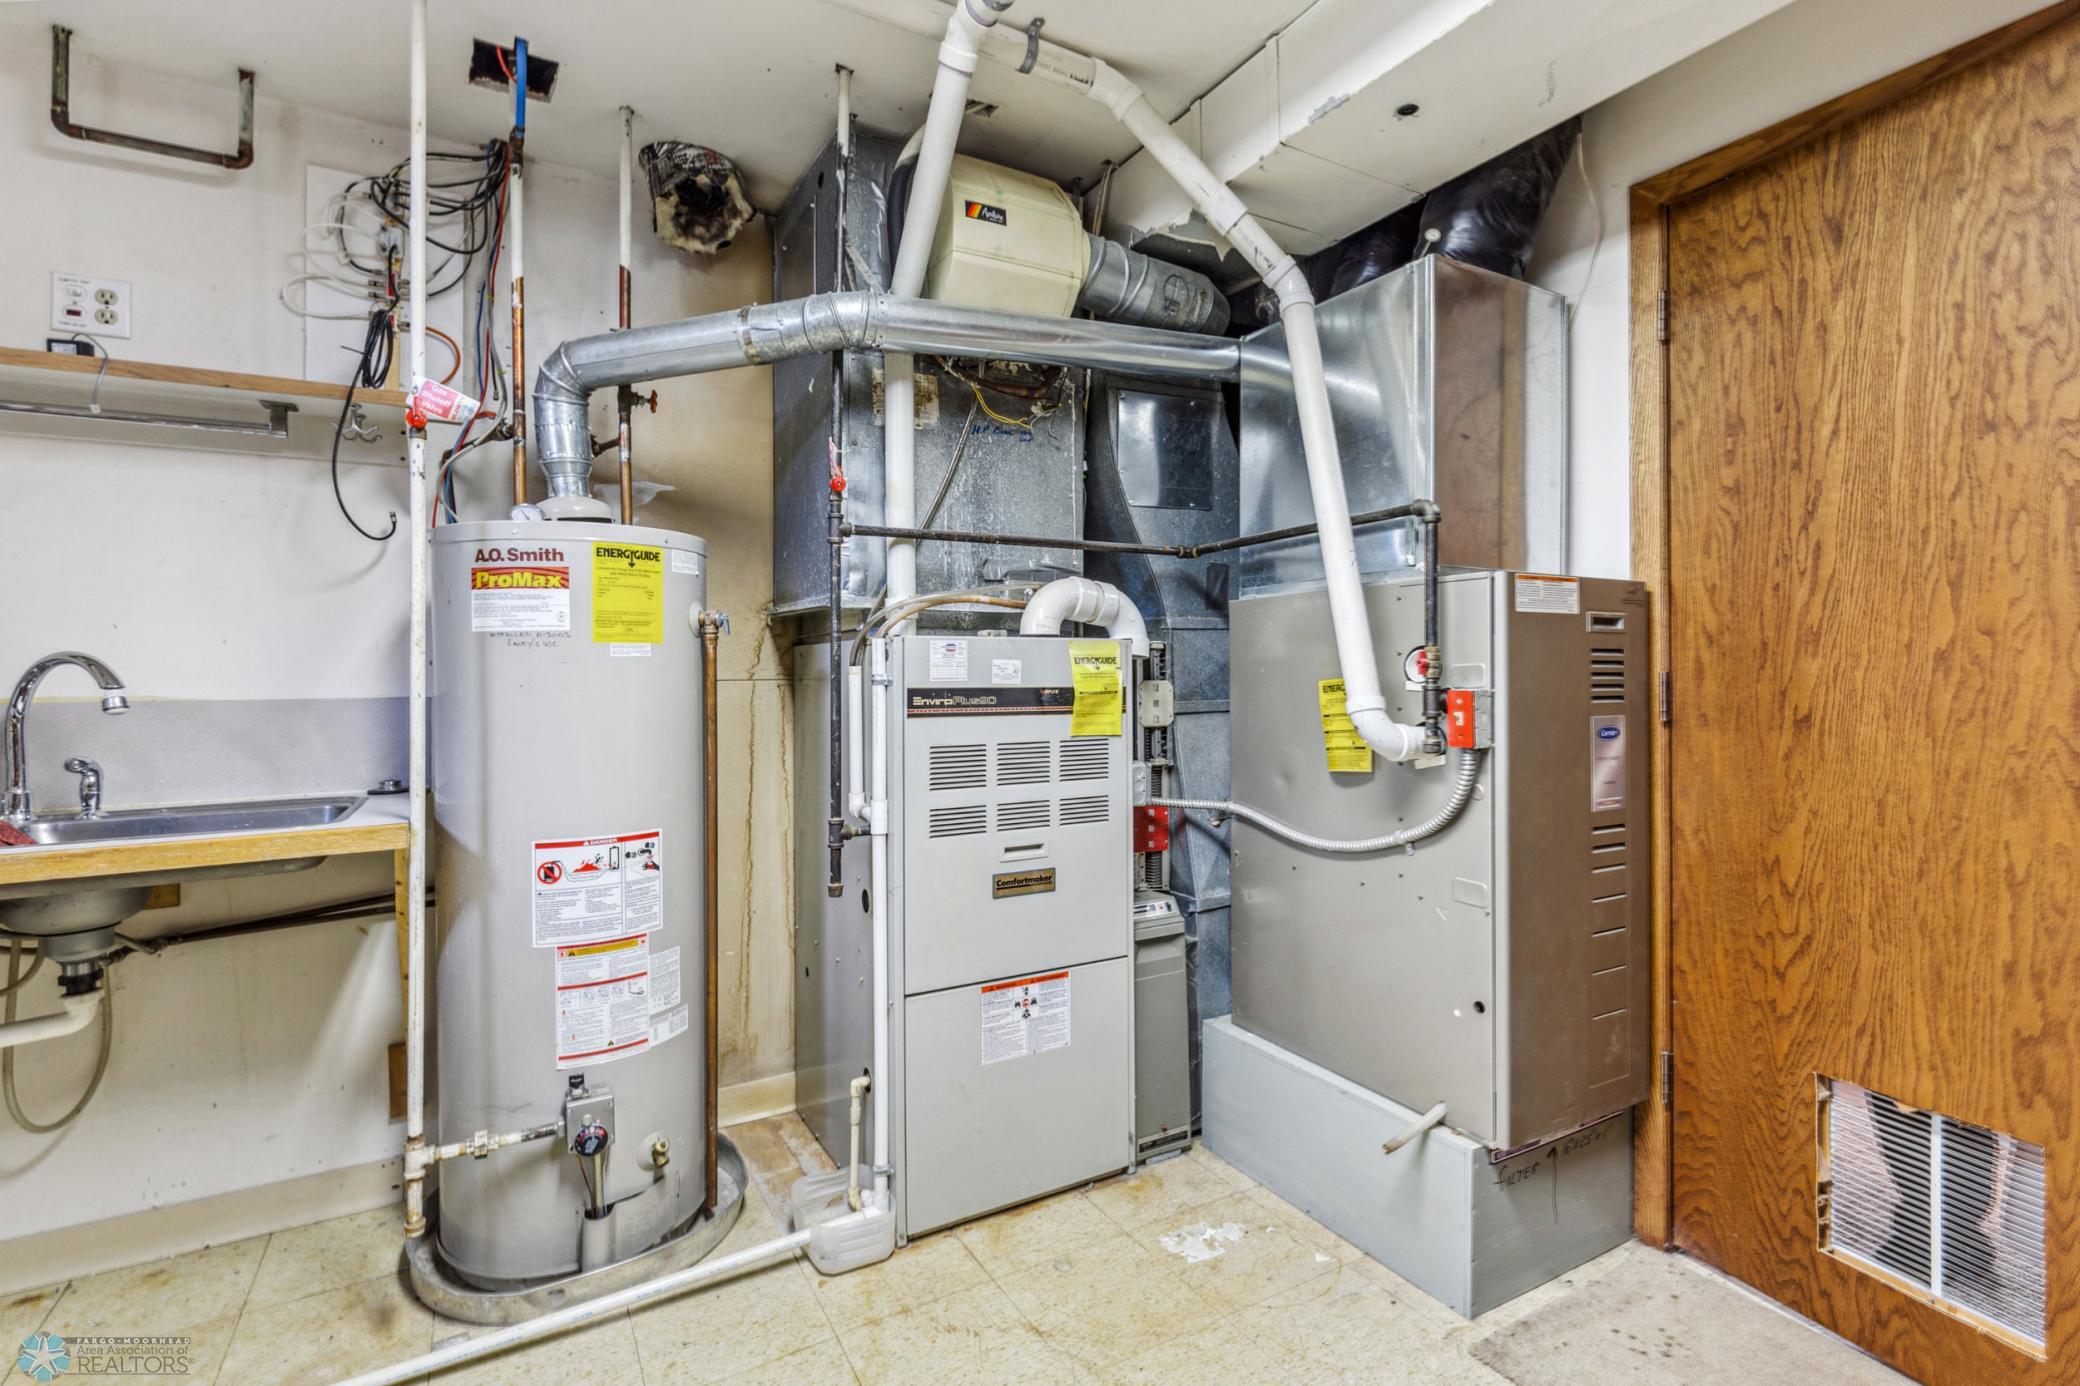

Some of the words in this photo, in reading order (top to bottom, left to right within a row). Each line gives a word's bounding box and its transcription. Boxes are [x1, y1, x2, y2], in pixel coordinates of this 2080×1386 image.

[475, 548, 505, 563] A.O.
[507, 547, 564, 562] Smith
[596, 547, 660, 563] ENERGYGUIDE
[476, 571, 562, 588] ProMax
[996, 874, 1052, 887] Comfortmaker
